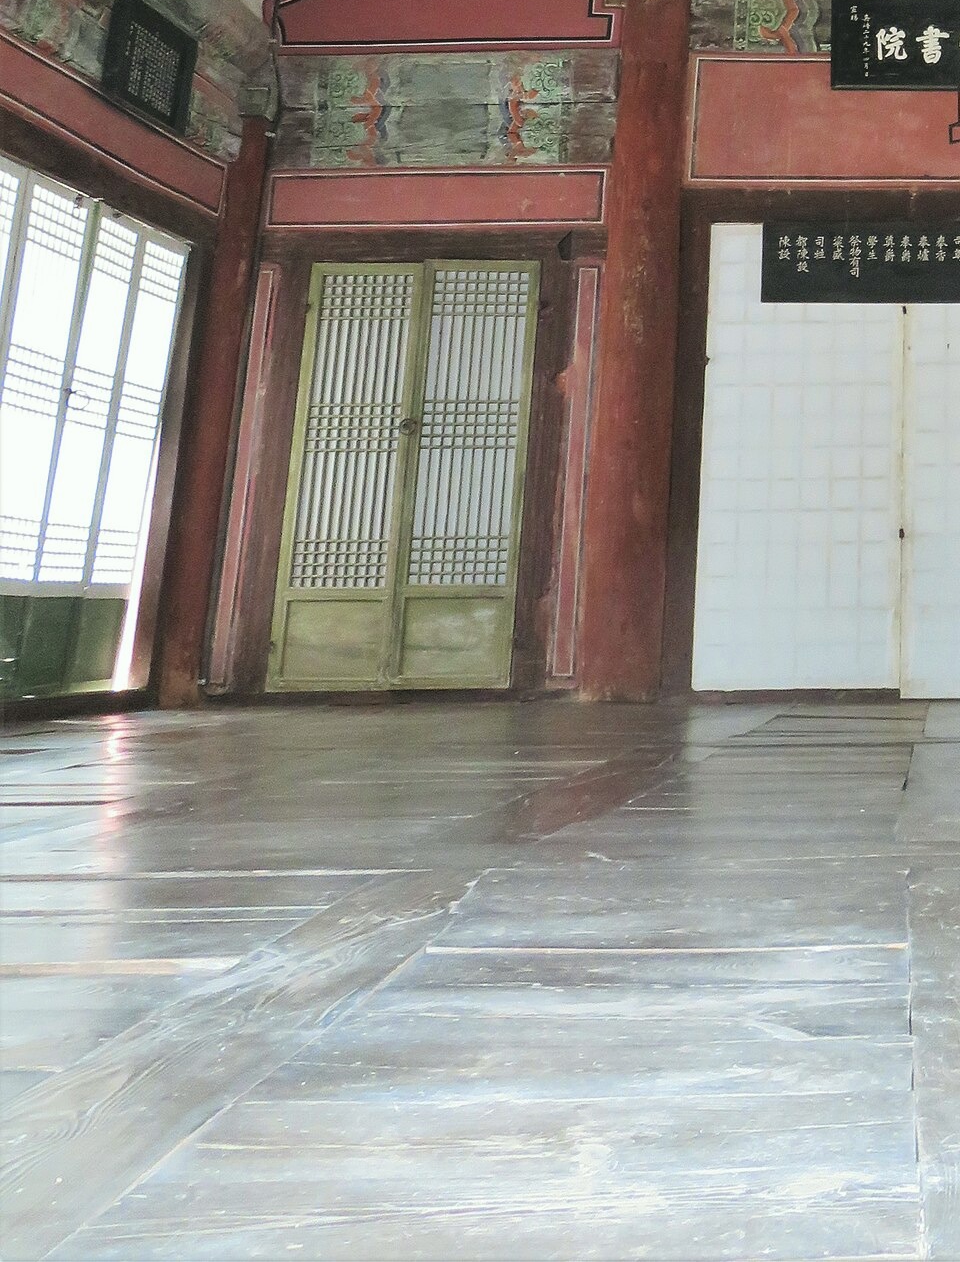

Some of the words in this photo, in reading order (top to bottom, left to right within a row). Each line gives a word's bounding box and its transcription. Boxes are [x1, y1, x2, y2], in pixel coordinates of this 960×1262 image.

[778, 236, 792, 260] 陳設
[848, 235, 862, 278] 祭物有司
[866, 236, 878, 261] 學生
[935, 235, 948, 262] 奉香
